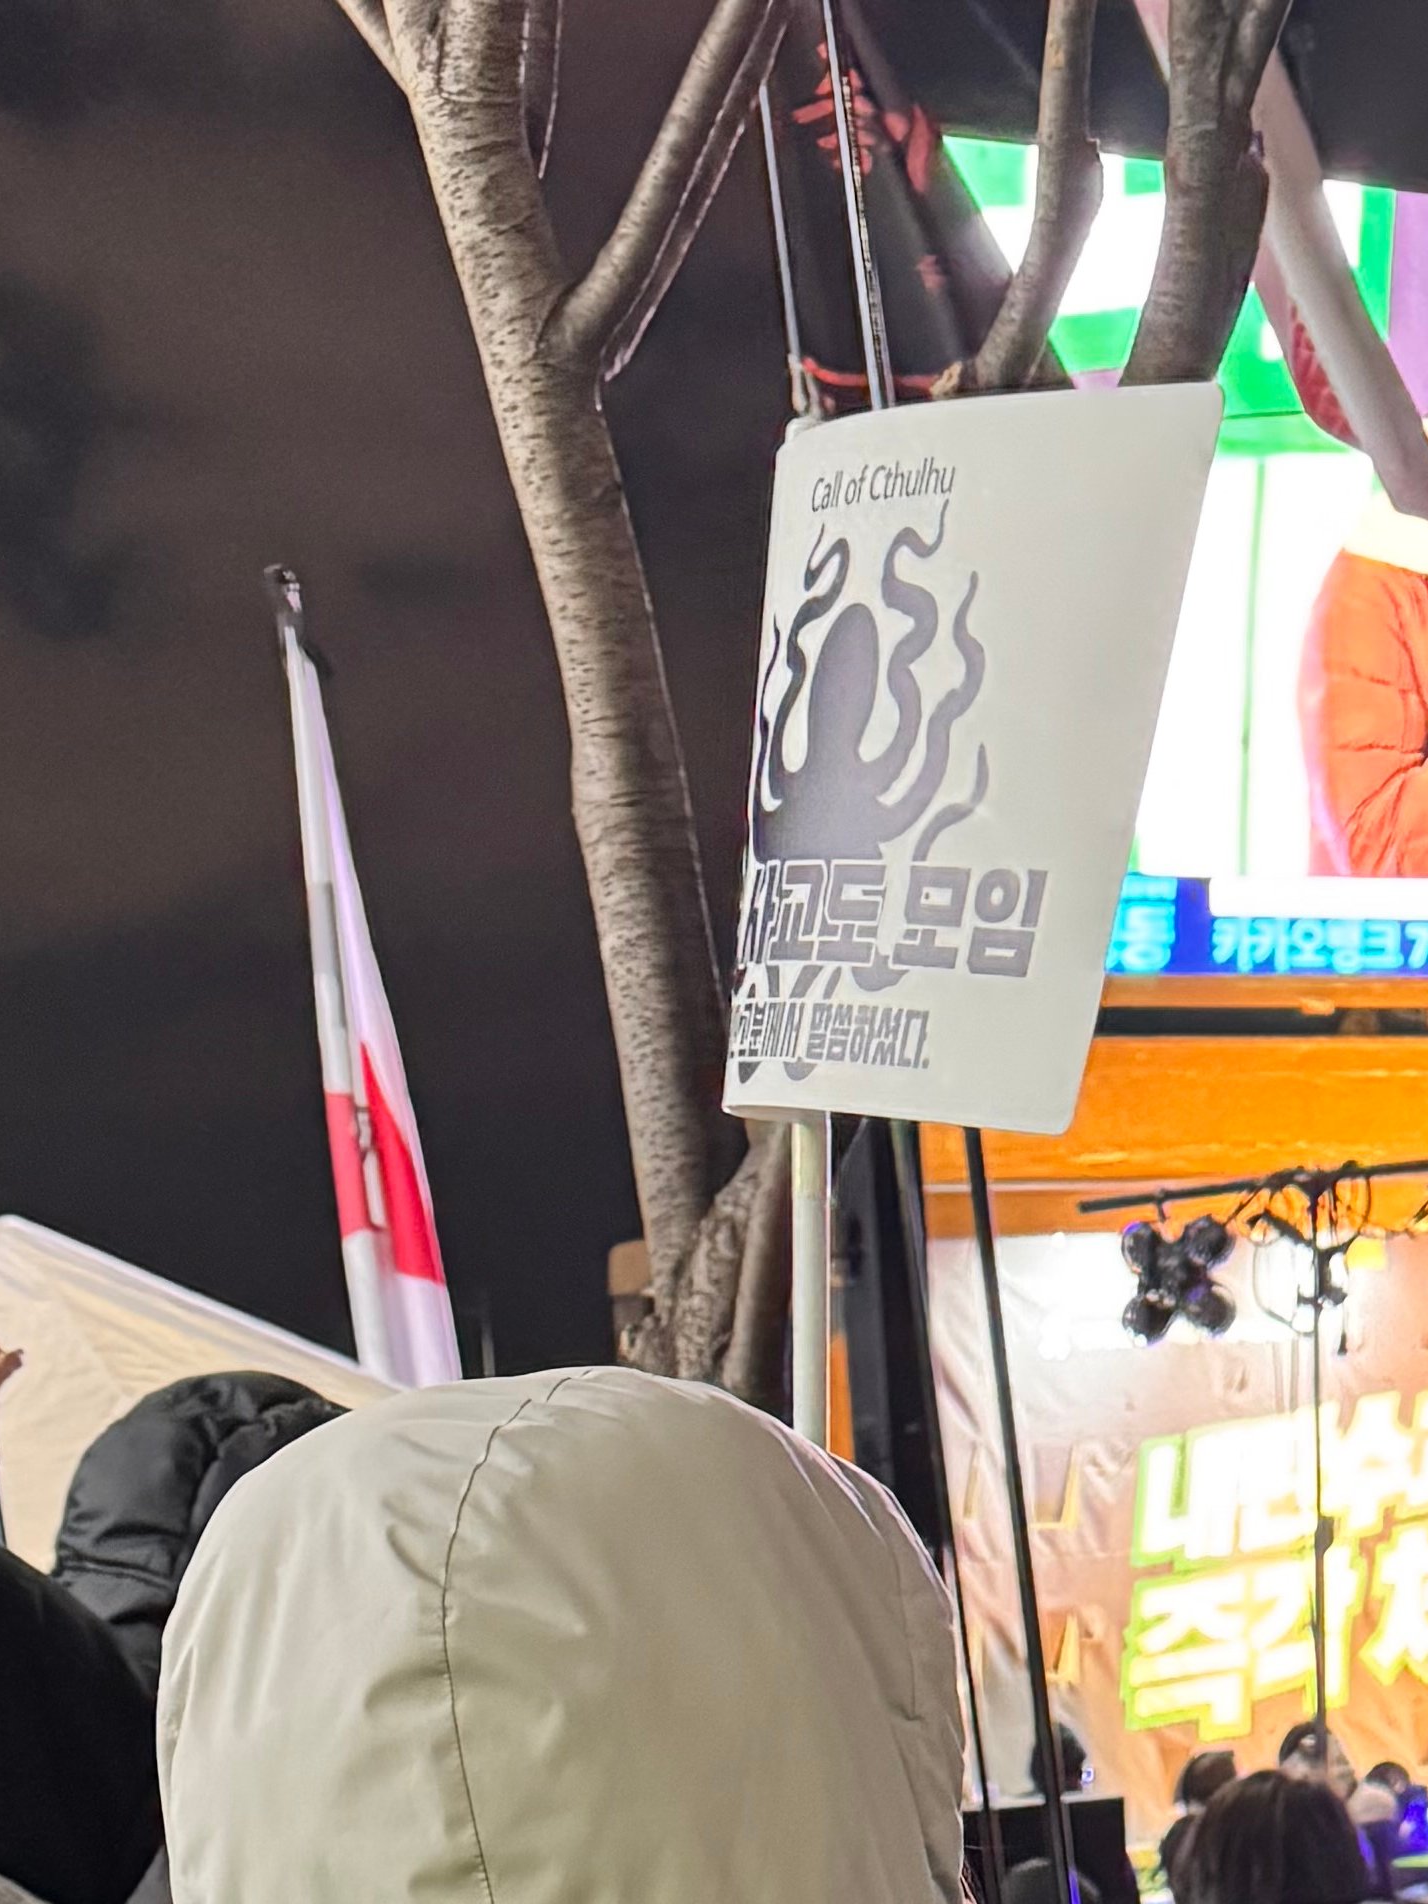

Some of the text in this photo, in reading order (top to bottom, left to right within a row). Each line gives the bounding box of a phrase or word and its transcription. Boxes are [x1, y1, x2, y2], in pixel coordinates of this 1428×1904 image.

[812, 458, 956, 513] Call of Cthulhu
[741, 860, 1048, 978] 사교도 모임
